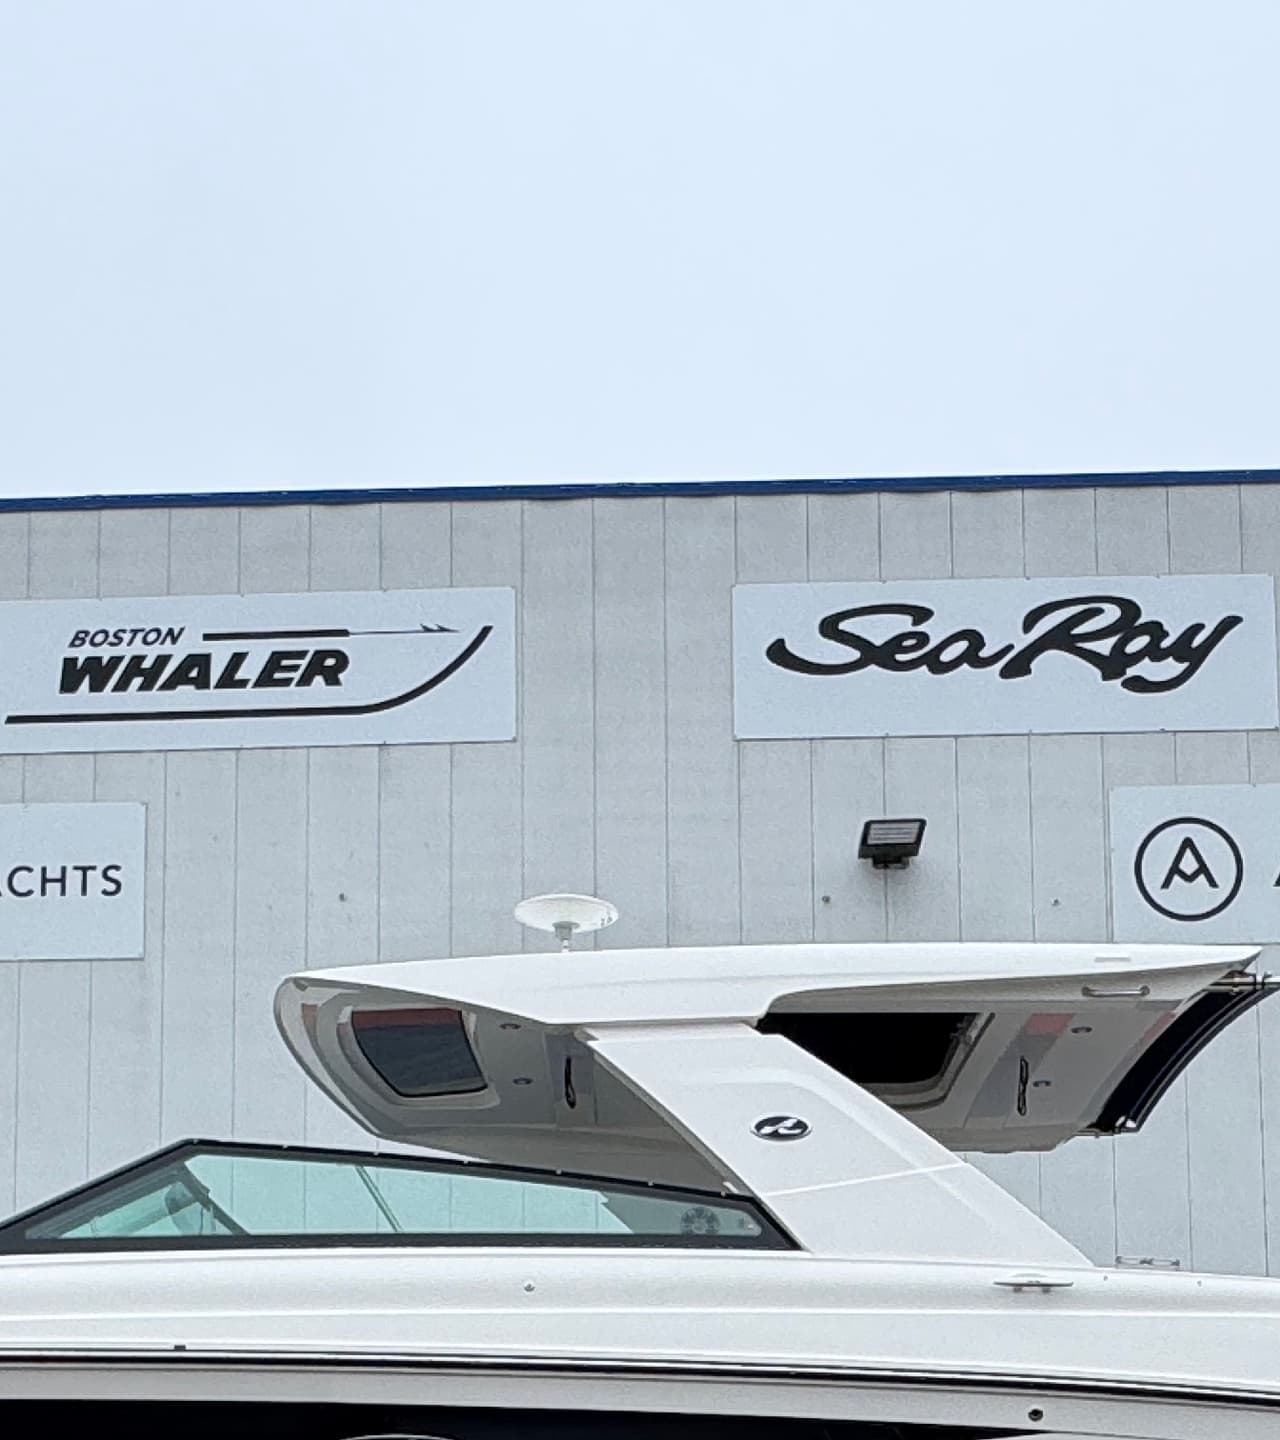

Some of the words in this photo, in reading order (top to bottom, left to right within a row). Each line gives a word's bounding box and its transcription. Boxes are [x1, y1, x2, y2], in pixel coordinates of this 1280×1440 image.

[68, 626, 185, 648] BOSTON
[765, 602, 1015, 676] Sea
[998, 595, 1244, 694] Ray
[58, 648, 351, 695] WHALER
